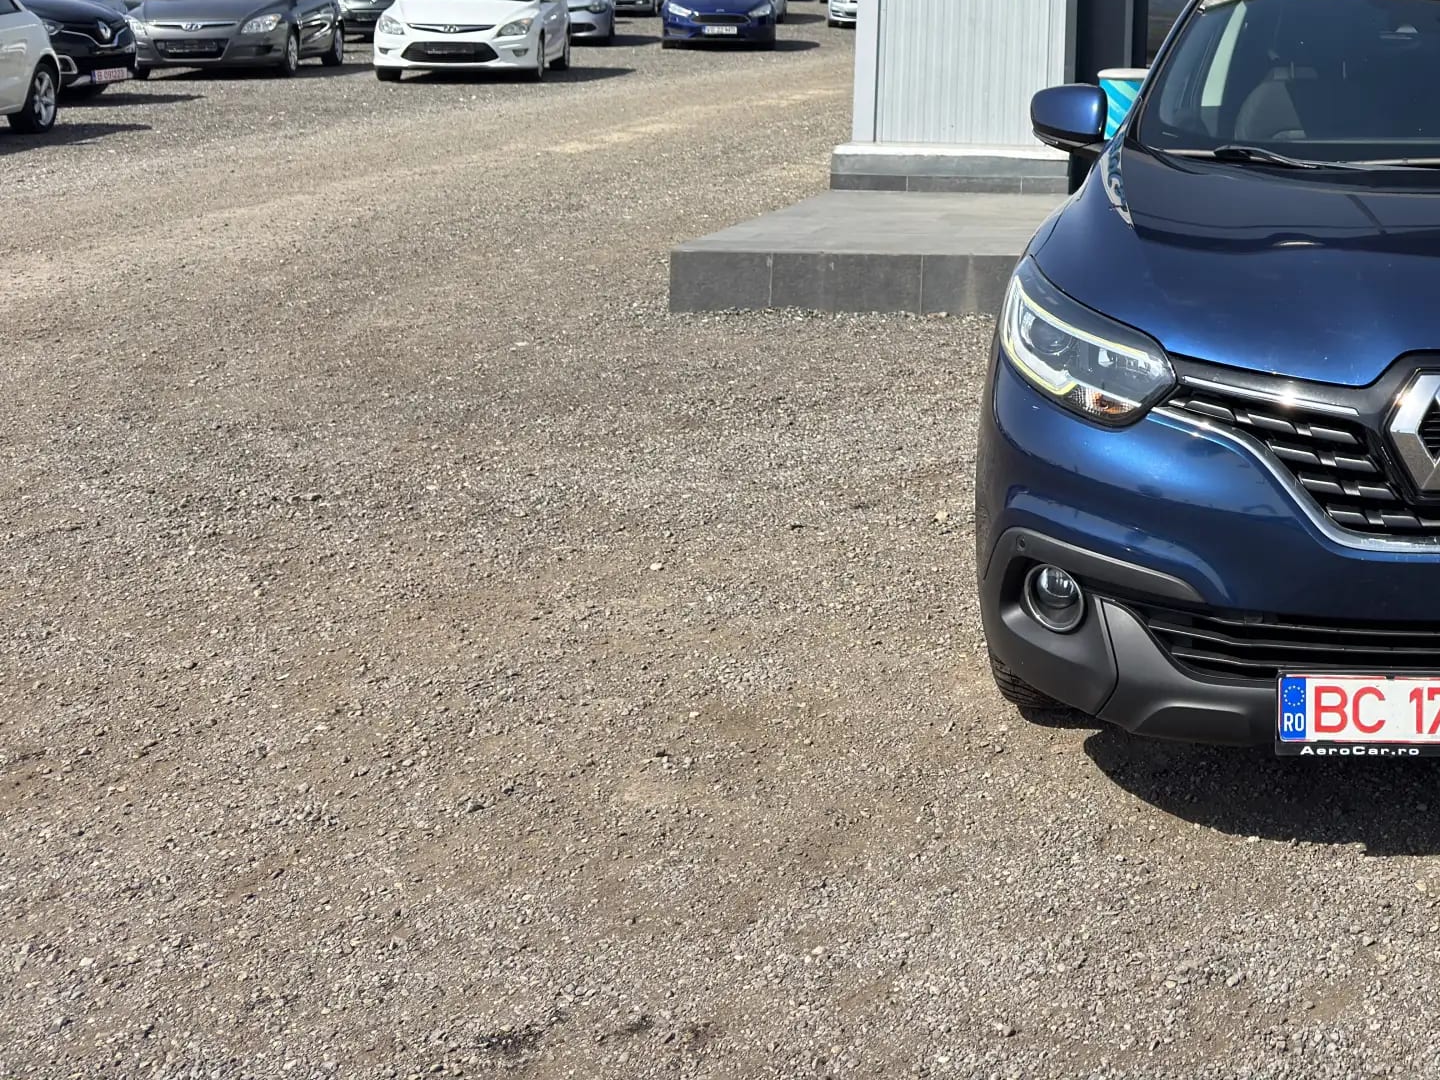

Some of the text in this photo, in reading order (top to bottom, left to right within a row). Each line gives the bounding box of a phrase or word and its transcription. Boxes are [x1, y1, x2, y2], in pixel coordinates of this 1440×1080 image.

[1283, 712, 1305, 732] RO
[1314, 685, 1386, 734] BC
[1300, 745, 1420, 756] AeroCar.ro
